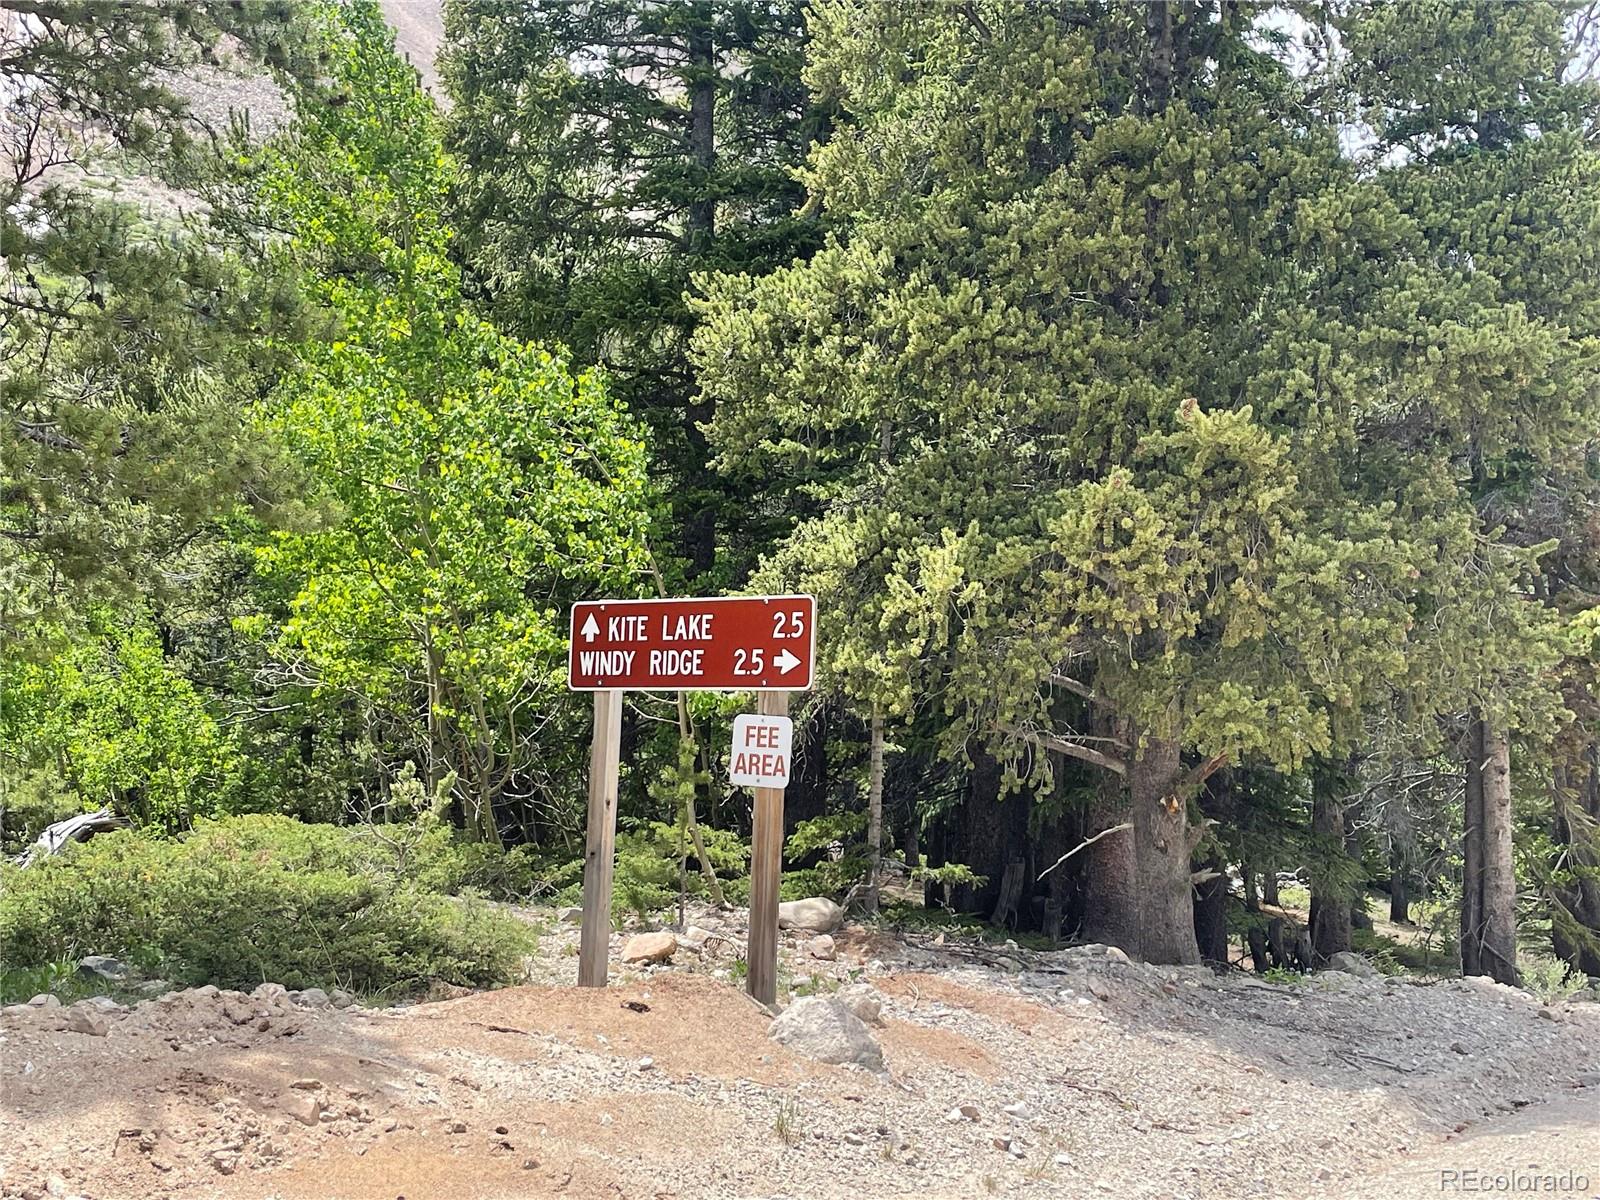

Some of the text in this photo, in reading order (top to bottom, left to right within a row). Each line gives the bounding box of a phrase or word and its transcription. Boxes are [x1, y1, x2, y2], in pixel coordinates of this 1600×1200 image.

[608, 611, 804, 642] KITE LAKE 2.5
[579, 648, 764, 676] WINDY RIDGE 2.5
[745, 725, 780, 749] FEE
[733, 752, 786, 777] AREA
